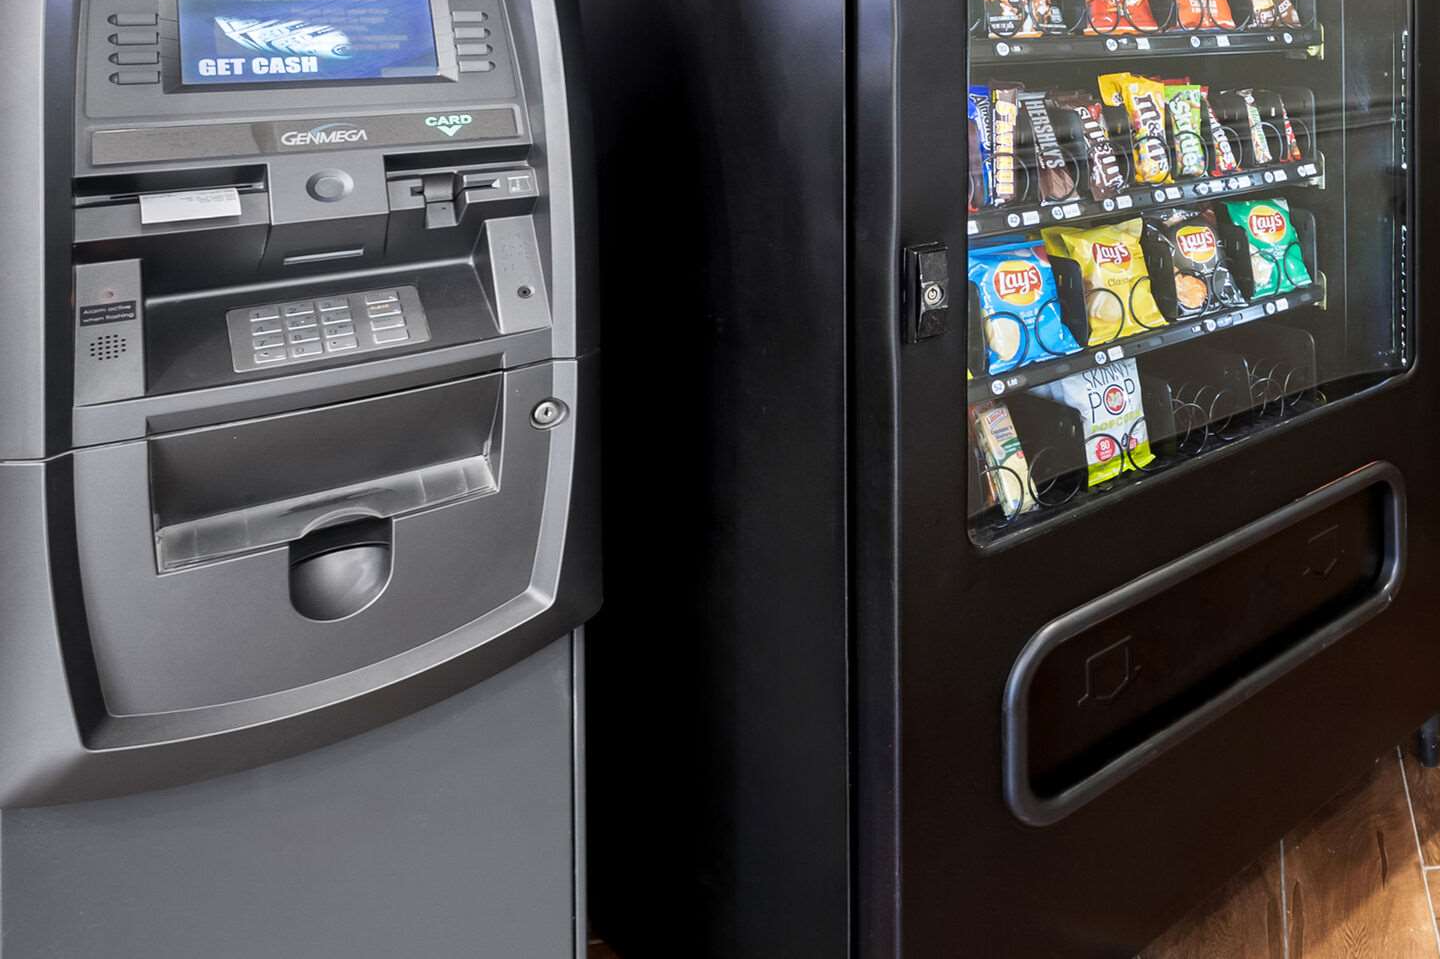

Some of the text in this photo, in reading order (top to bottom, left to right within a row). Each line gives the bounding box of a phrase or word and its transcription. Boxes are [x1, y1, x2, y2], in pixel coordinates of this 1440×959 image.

[198, 55, 319, 77] GET CASH
[424, 113, 473, 128] CARD
[281, 128, 368, 146] GENMEGA
[1252, 213, 1283, 235] Lay's
[1180, 230, 1214, 252] Lay's
[1095, 242, 1130, 265] Lay's
[999, 266, 1038, 296] Lay's
